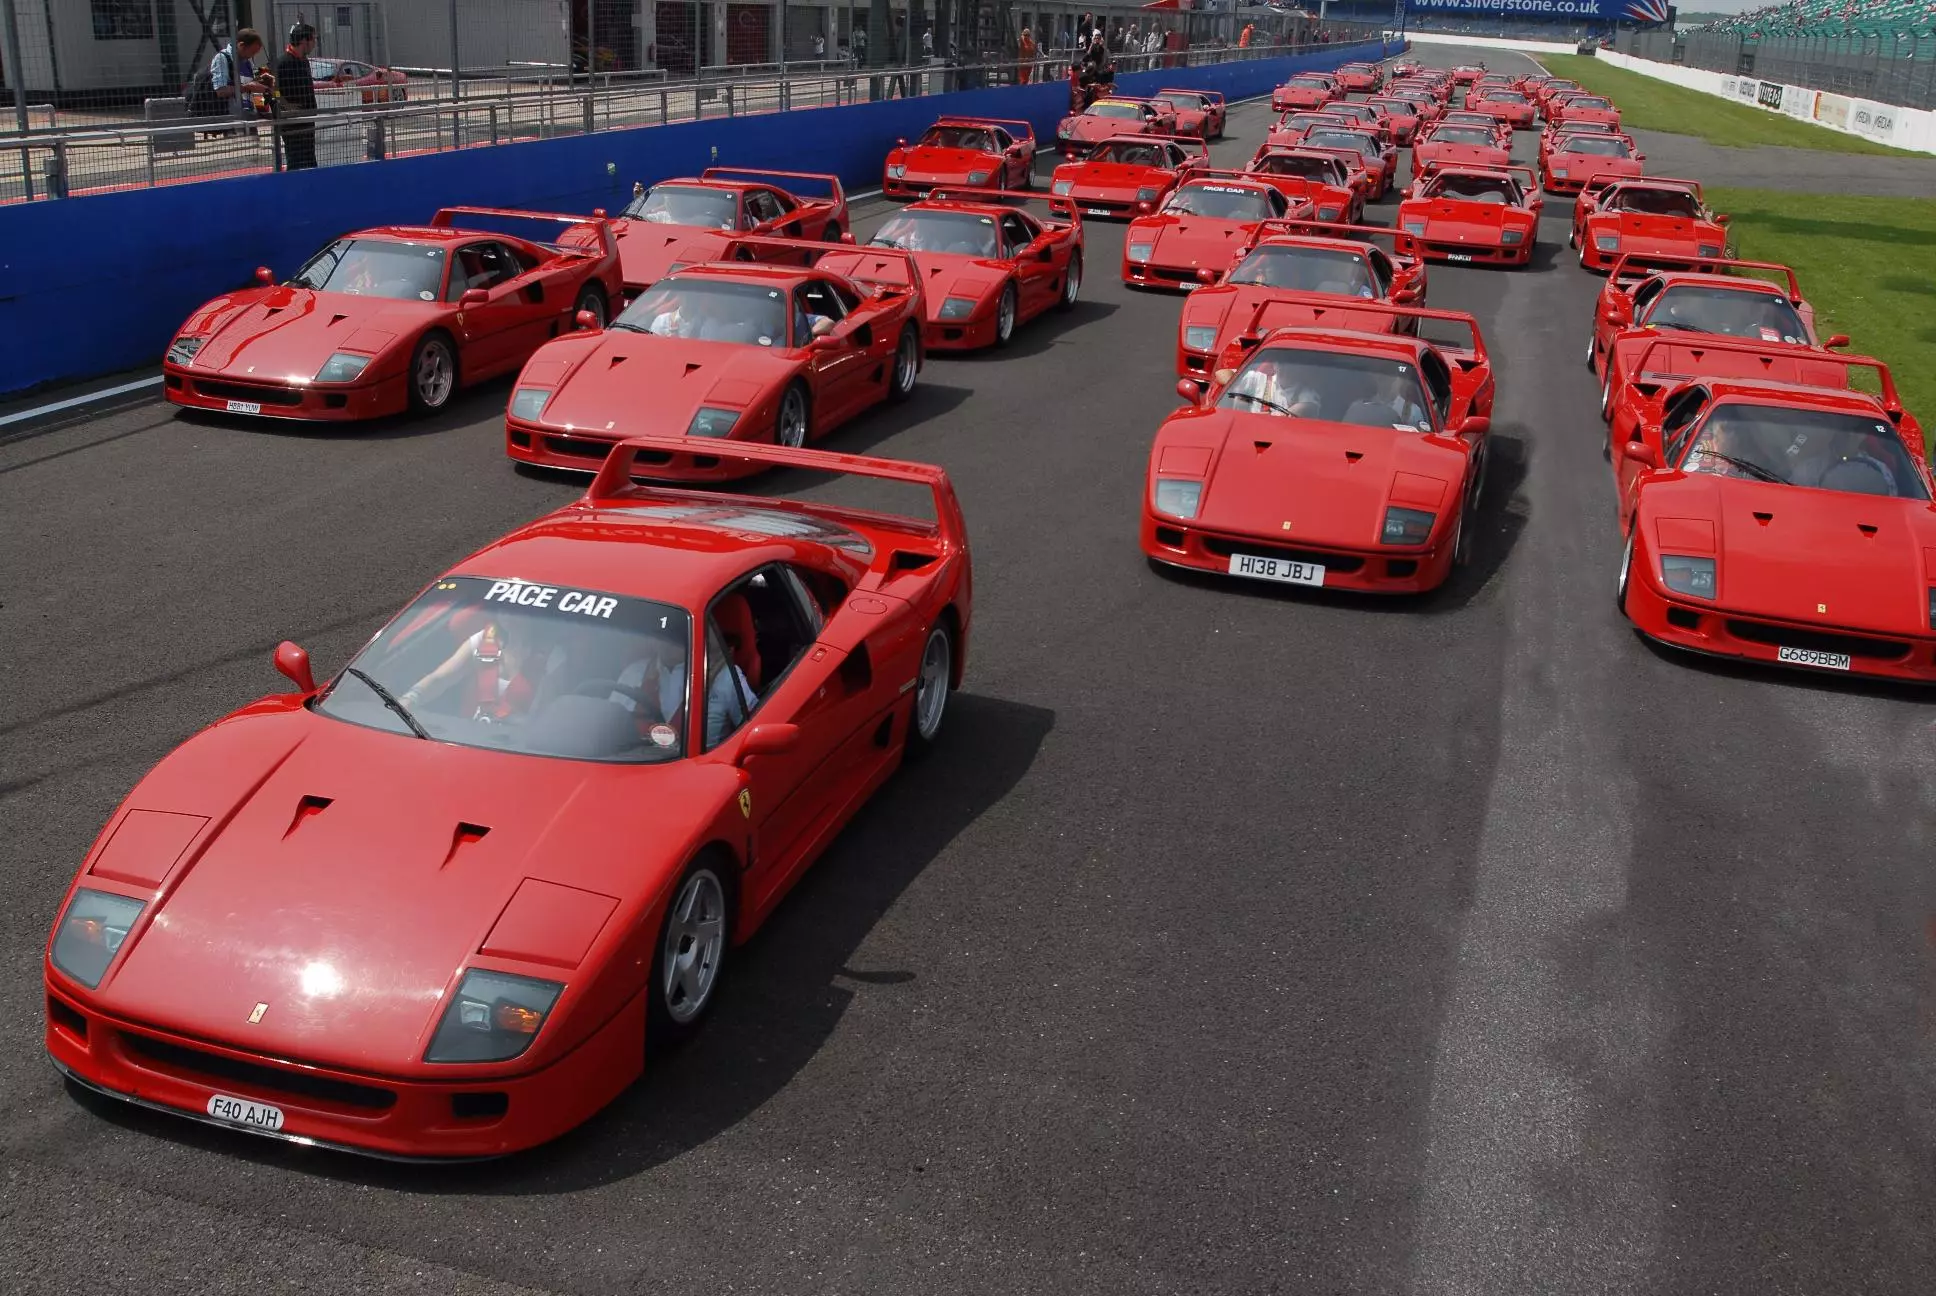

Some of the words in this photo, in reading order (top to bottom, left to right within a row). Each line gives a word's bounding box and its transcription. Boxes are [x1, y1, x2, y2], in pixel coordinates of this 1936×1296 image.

[1415, 0, 1600, 13] www.silverstone.co.uk
[1875, 425, 1886, 433] 12
[1240, 557, 1277, 575] H138
[1281, 563, 1315, 580] JBJ
[483, 581, 558, 608] PACE
[557, 592, 618, 618] CAR
[660, 616, 667, 629] 1
[1780, 647, 1849, 668] G689BBM
[212, 1098, 242, 1119] F40
[244, 1106, 278, 1127] AJH
